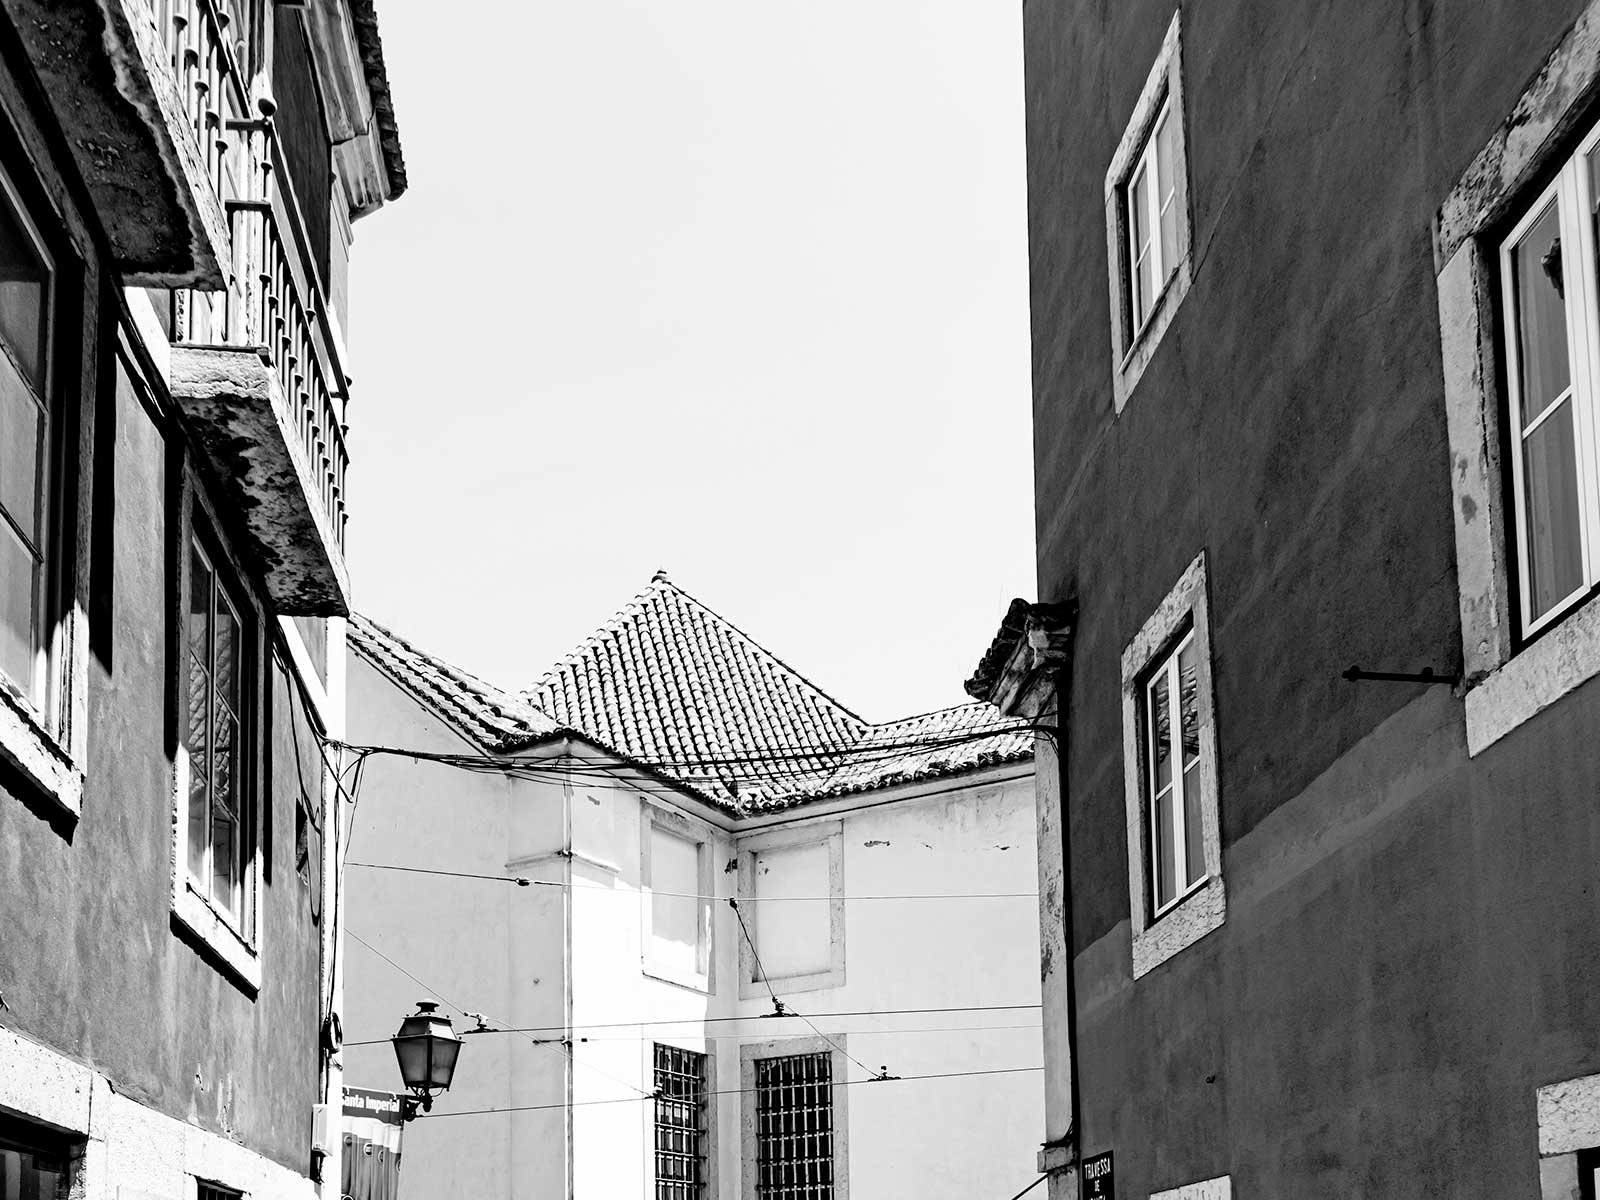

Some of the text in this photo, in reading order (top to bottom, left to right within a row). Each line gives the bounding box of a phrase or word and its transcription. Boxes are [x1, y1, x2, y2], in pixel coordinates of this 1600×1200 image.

[366, 1095, 400, 1114] Imperial
[1084, 1157, 1111, 1180] TRAVESSA
[1094, 1180, 1100, 1192] DE
